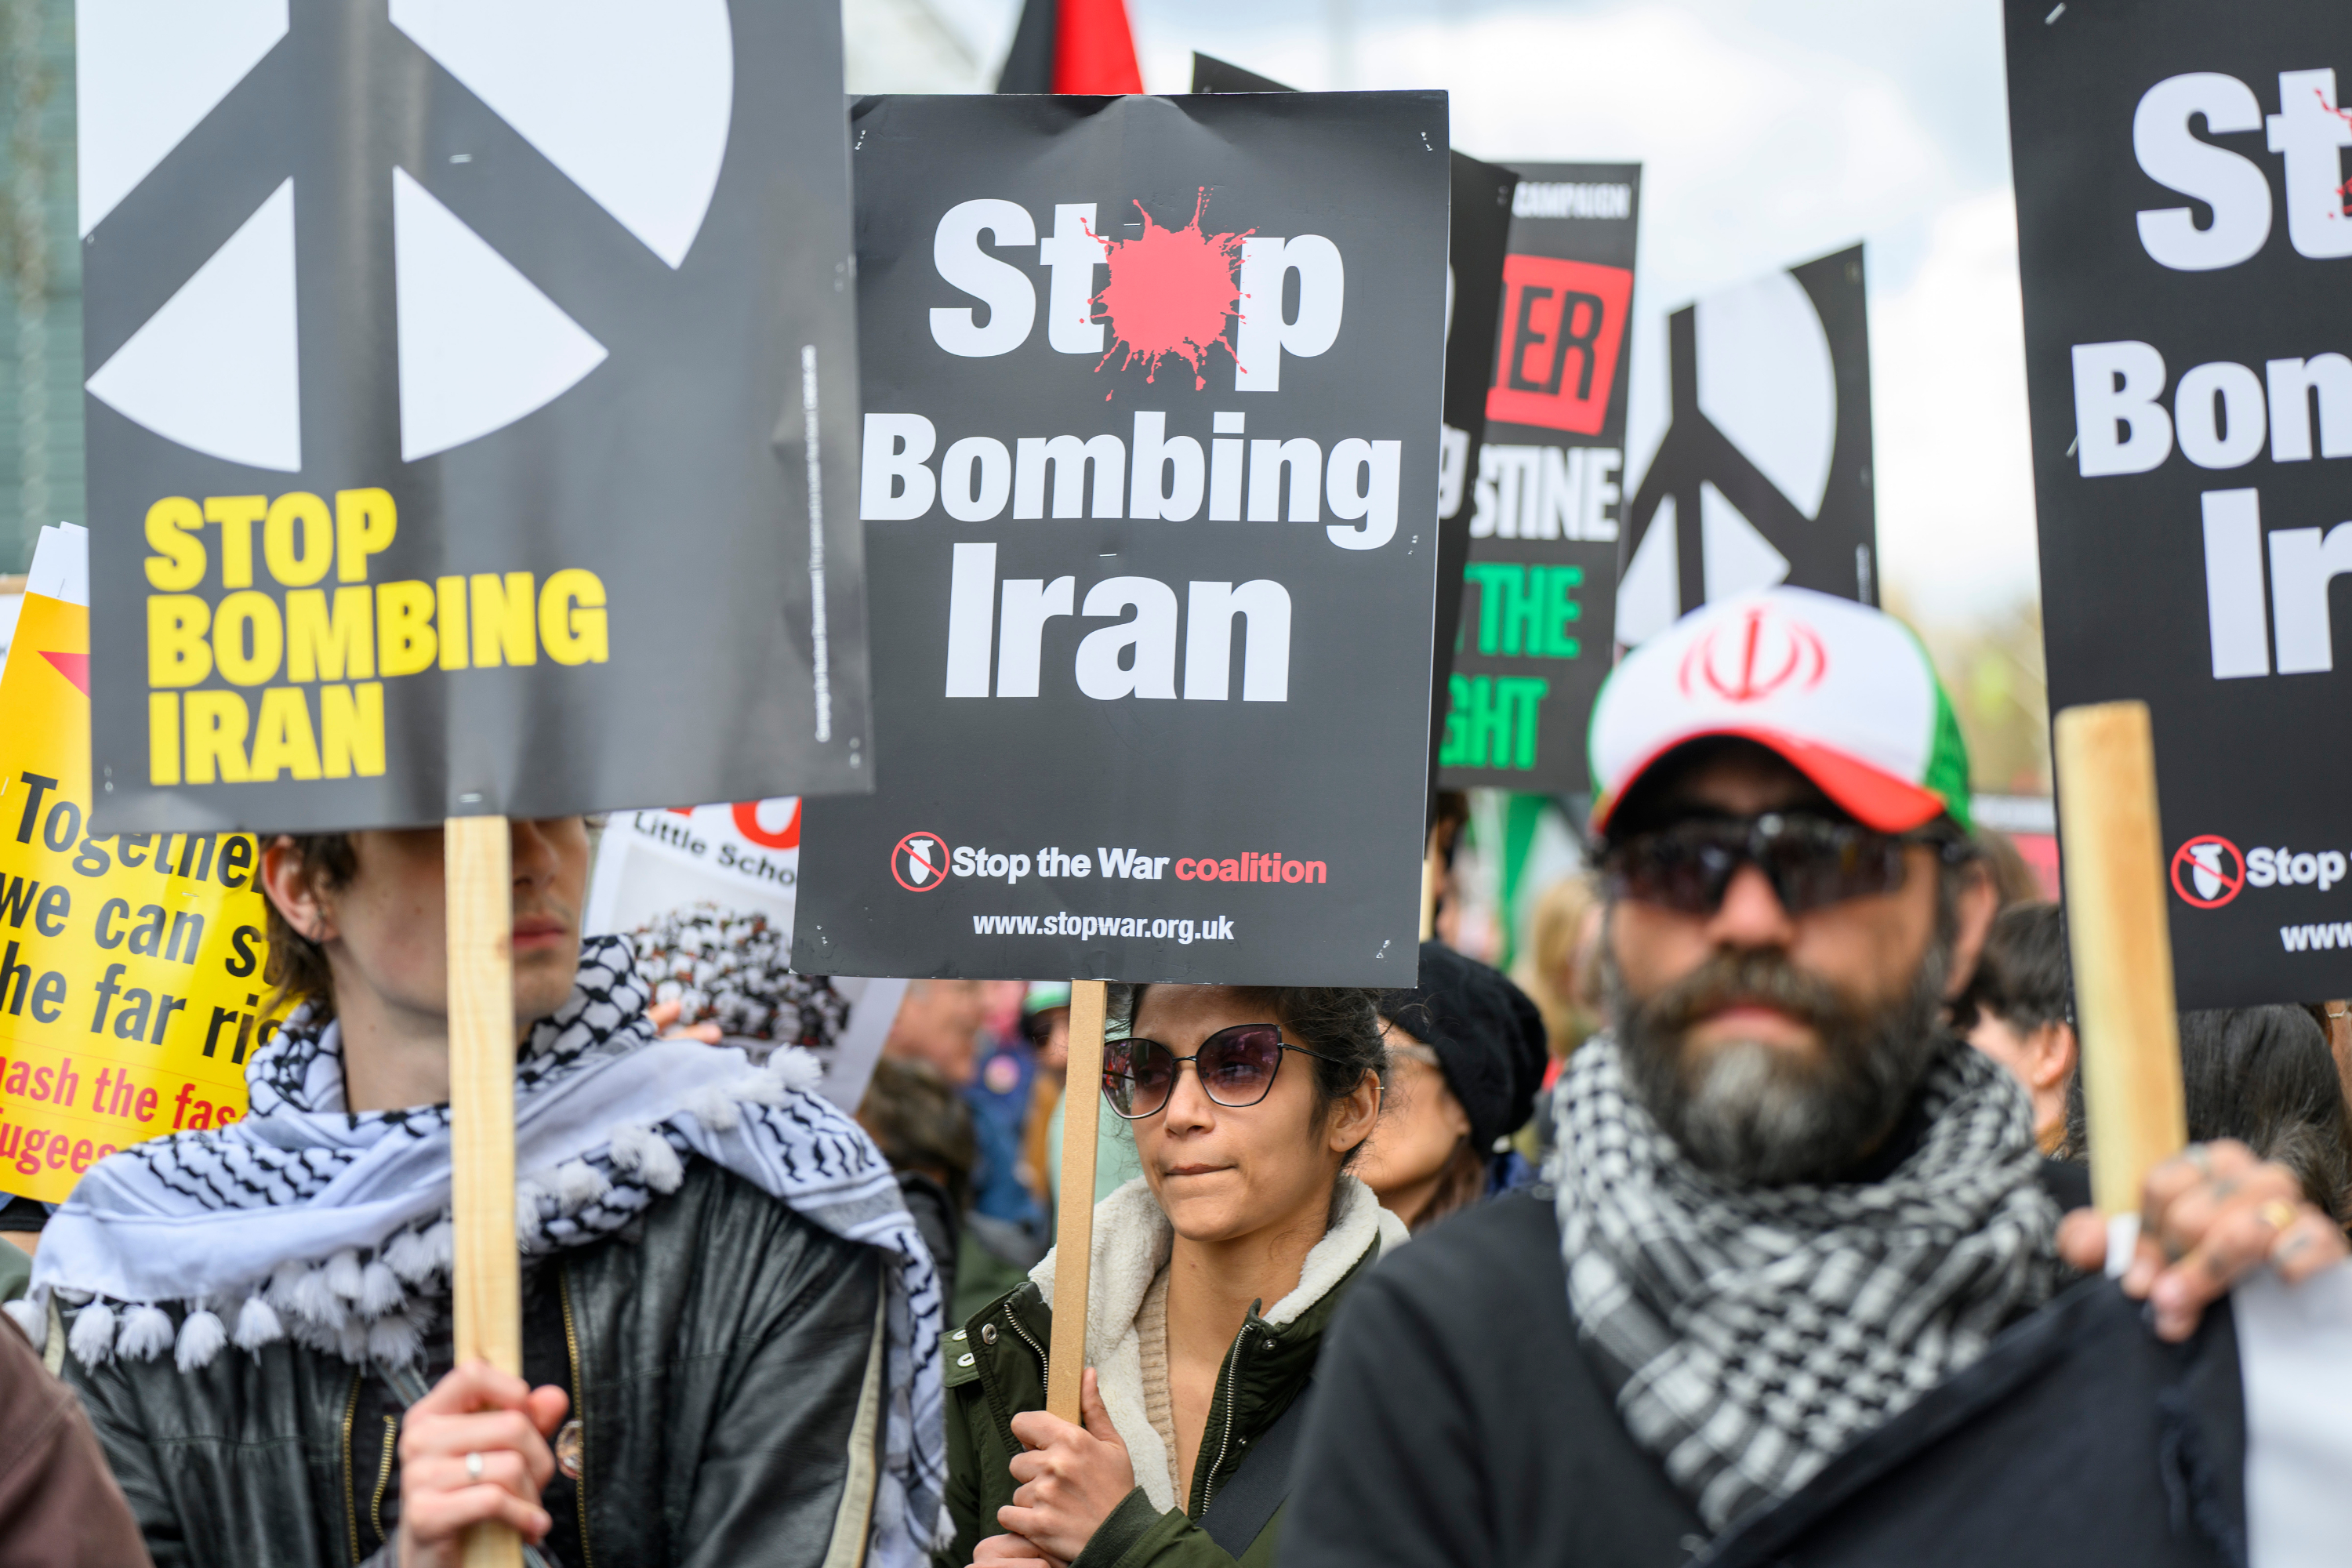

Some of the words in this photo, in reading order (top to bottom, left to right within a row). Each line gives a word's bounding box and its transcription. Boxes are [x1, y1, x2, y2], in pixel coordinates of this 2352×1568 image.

[859, 411, 1402, 550] Bombing
[144, 487, 397, 592] STOP
[147, 568, 609, 688] BOMBING
[946, 542, 1292, 702] Iran
[148, 681, 387, 786] IRAN
[16, 771, 263, 895] Togethe
[634, 811, 708, 856] Little
[951, 846, 1031, 884] Stop
[1037, 847, 1092, 878] the
[1097, 847, 1171, 880] War
[1175, 851, 1327, 884] coalition
[2245, 846, 2347, 891] Stop
[95, 897, 205, 965] can
[973, 911, 1235, 945] www.stopwar.org.uk
[90, 963, 187, 1046] far
[0, 1055, 79, 1107] ash
[92, 1067, 158, 1123] the
